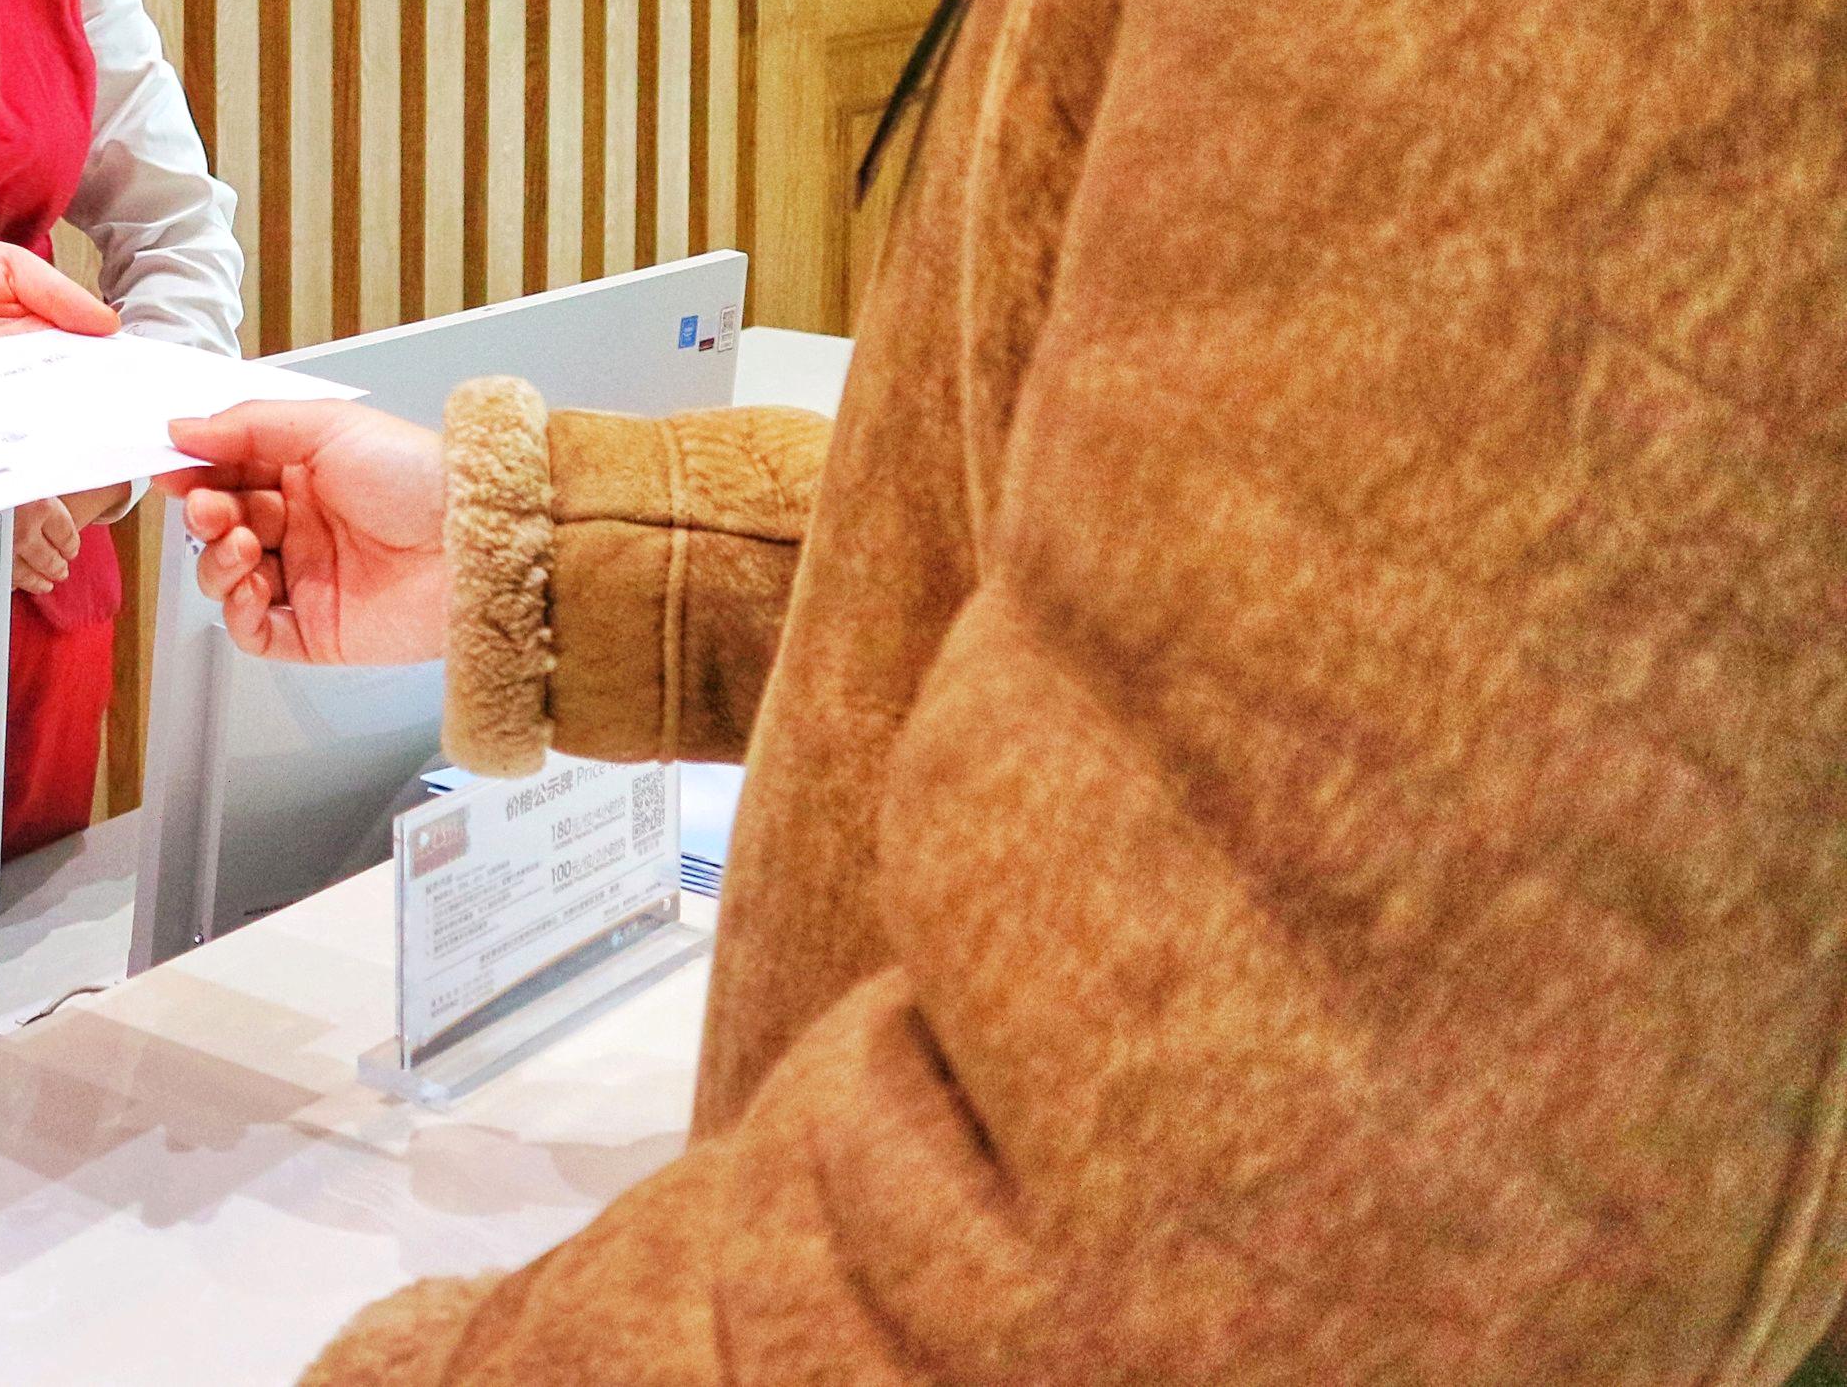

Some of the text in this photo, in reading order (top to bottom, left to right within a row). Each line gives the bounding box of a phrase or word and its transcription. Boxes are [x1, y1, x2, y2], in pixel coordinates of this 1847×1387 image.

[506, 769, 573, 822] 价格公示牌
